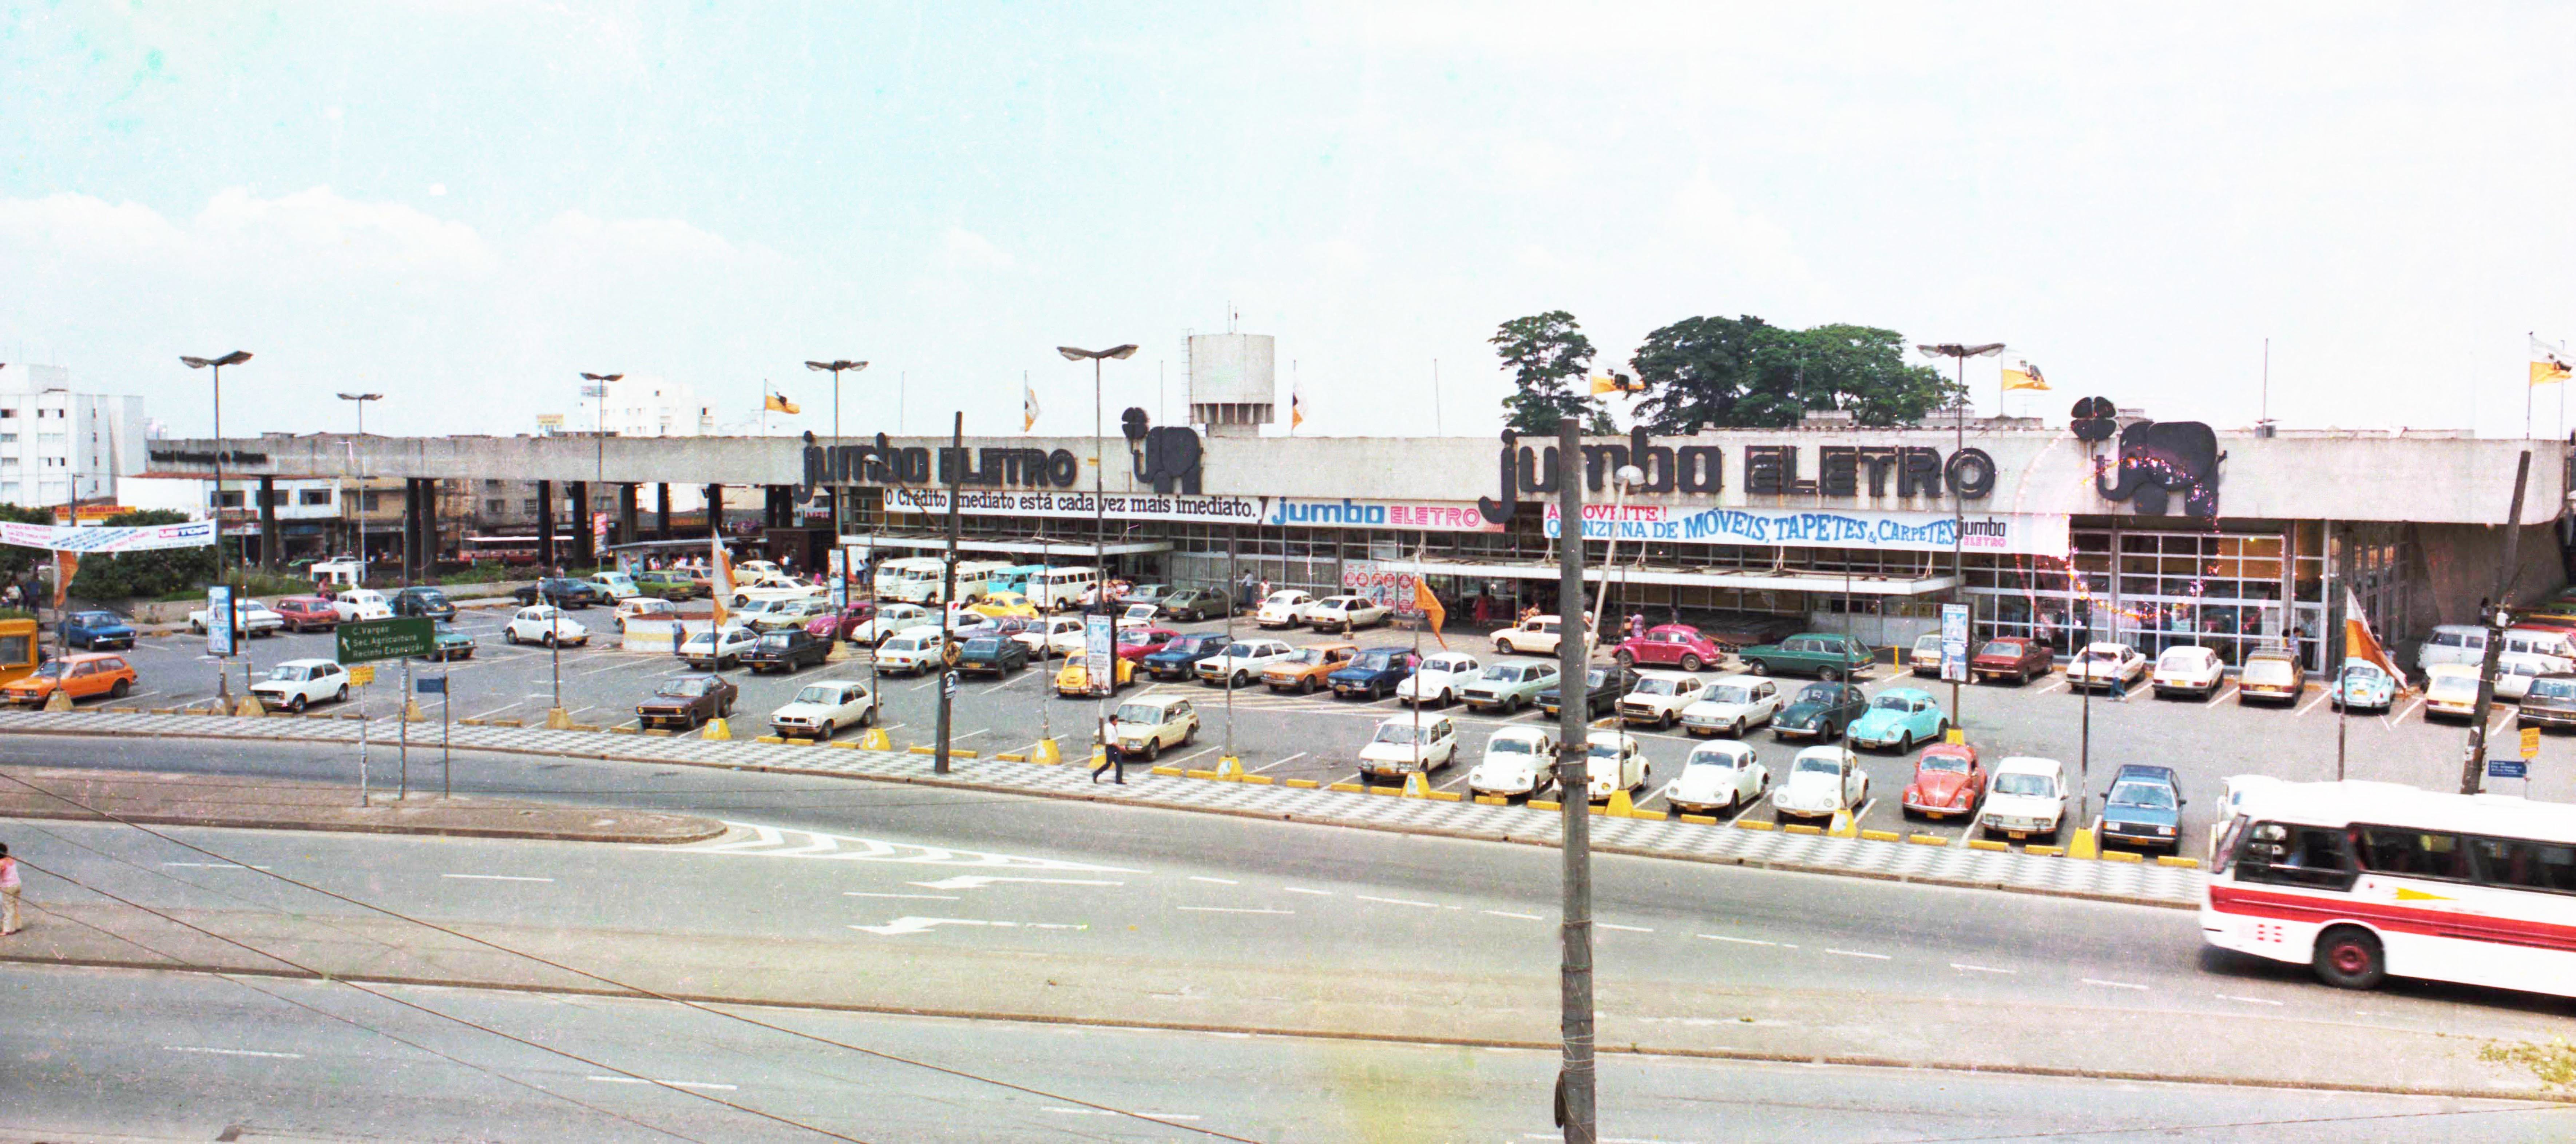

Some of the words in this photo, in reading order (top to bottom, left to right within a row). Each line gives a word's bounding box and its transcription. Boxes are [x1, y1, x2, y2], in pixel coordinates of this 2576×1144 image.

[792, 430, 930, 504] jumbo
[939, 447, 1078, 487] ELETRO
[1478, 425, 1722, 524] jumbo
[1745, 445, 1996, 500] ELETRO
[885, 489, 893, 505] O
[898, 488, 947, 507] Crédito
[957, 490, 1015, 509] mediato
[1020, 492, 1052, 510] está
[1058, 493, 1095, 511] cada
[1099, 497, 1126, 512] vez
[1130, 494, 1170, 513] mais
[1175, 496, 1256, 517] imediato.
[1272, 496, 1385, 525] jumbo
[1390, 505, 1480, 527] ELETRO
[1653, 521, 1678, 539] DE
[1774, 513, 1868, 541] TAPETES
[1868, 531, 1877, 544] &
[1878, 519, 1956, 545] CARPETES
[1955, 516, 2006, 540] jumbo
[1964, 536, 2006, 547] ELETRO
[371, 634, 417, 647] Agricultura
